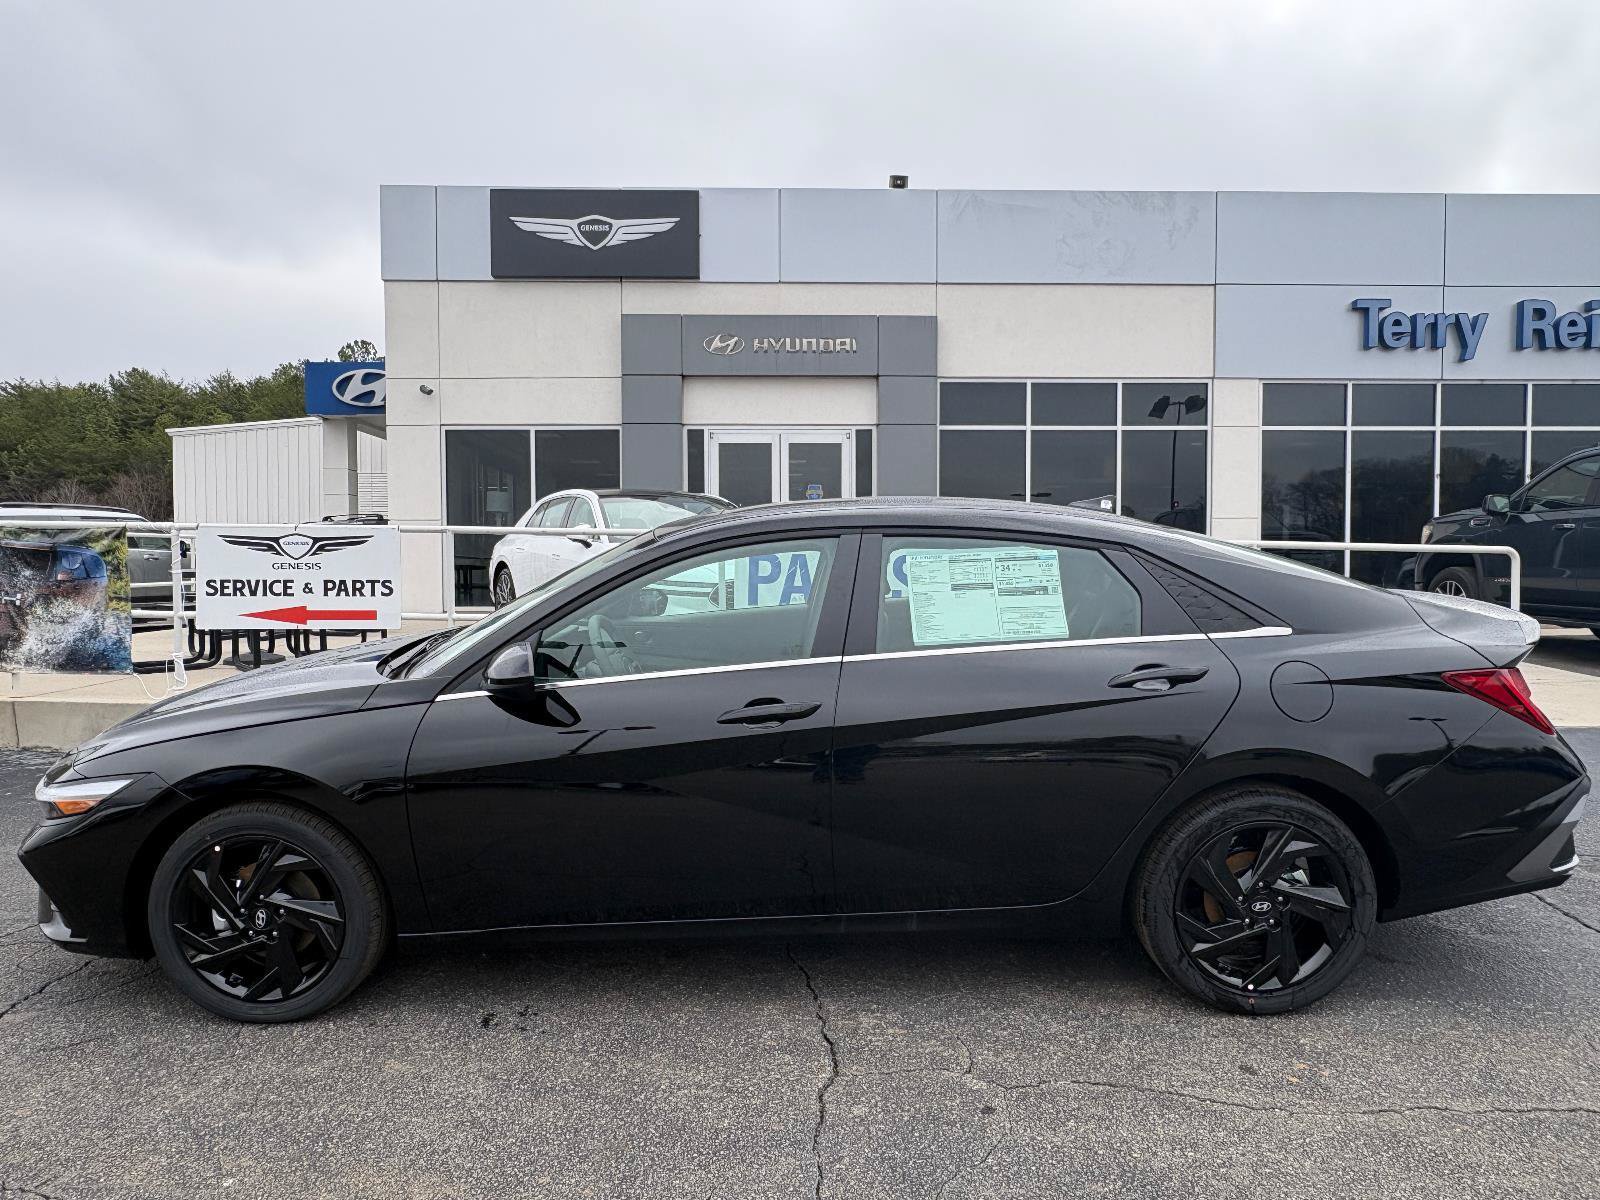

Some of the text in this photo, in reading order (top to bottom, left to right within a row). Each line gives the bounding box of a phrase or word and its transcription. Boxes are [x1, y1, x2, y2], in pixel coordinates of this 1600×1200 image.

[580, 224, 610, 232] GENESIS
[1351, 298, 1489, 361] Terry
[753, 337, 857, 353] HYUNDAI
[271, 562, 322, 571] GENESIS
[205, 579, 394, 597] SERVICE & PARTS
